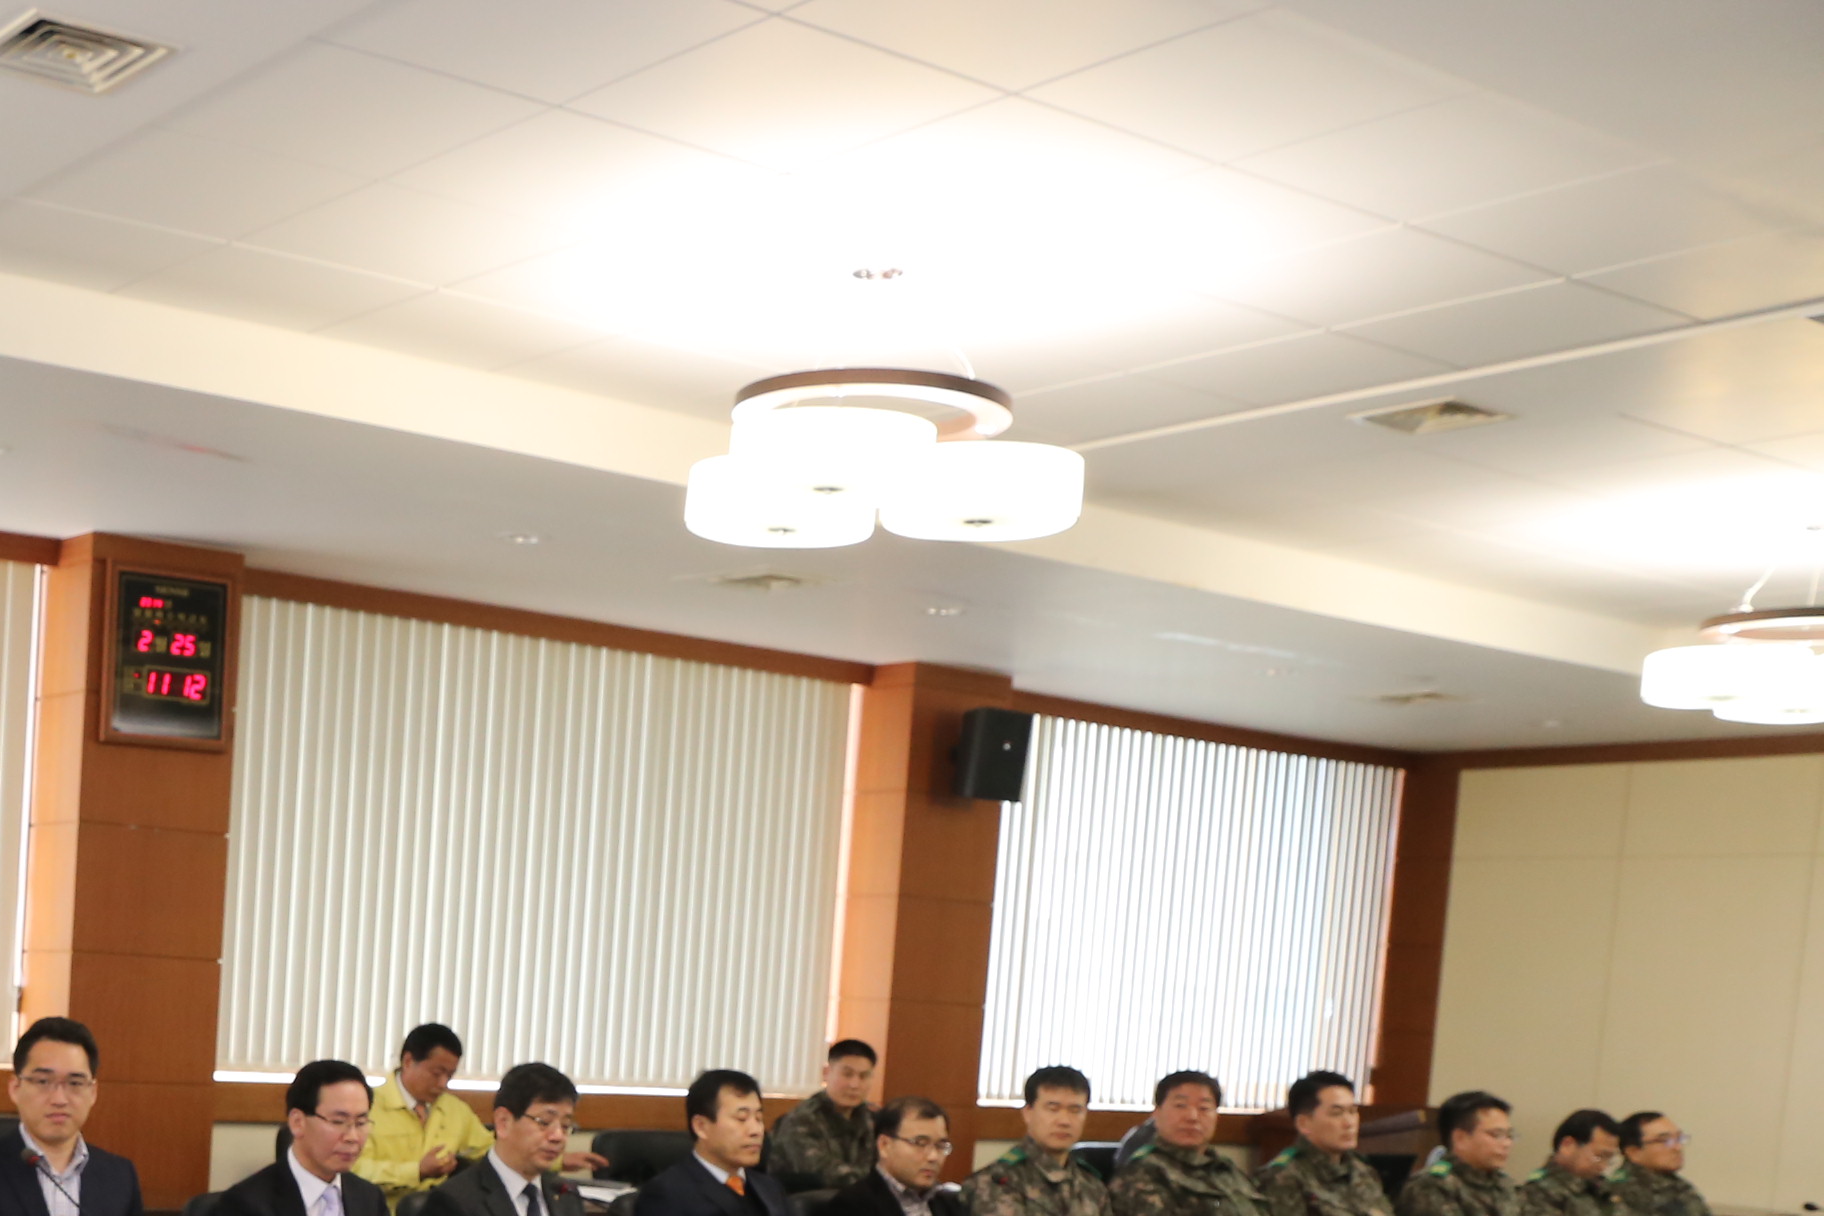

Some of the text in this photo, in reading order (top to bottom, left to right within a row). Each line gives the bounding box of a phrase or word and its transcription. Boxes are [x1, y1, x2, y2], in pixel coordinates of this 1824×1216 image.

[137, 629, 154, 652] 2
[170, 633, 197, 657] 25
[146, 671, 207, 700] 11 12
